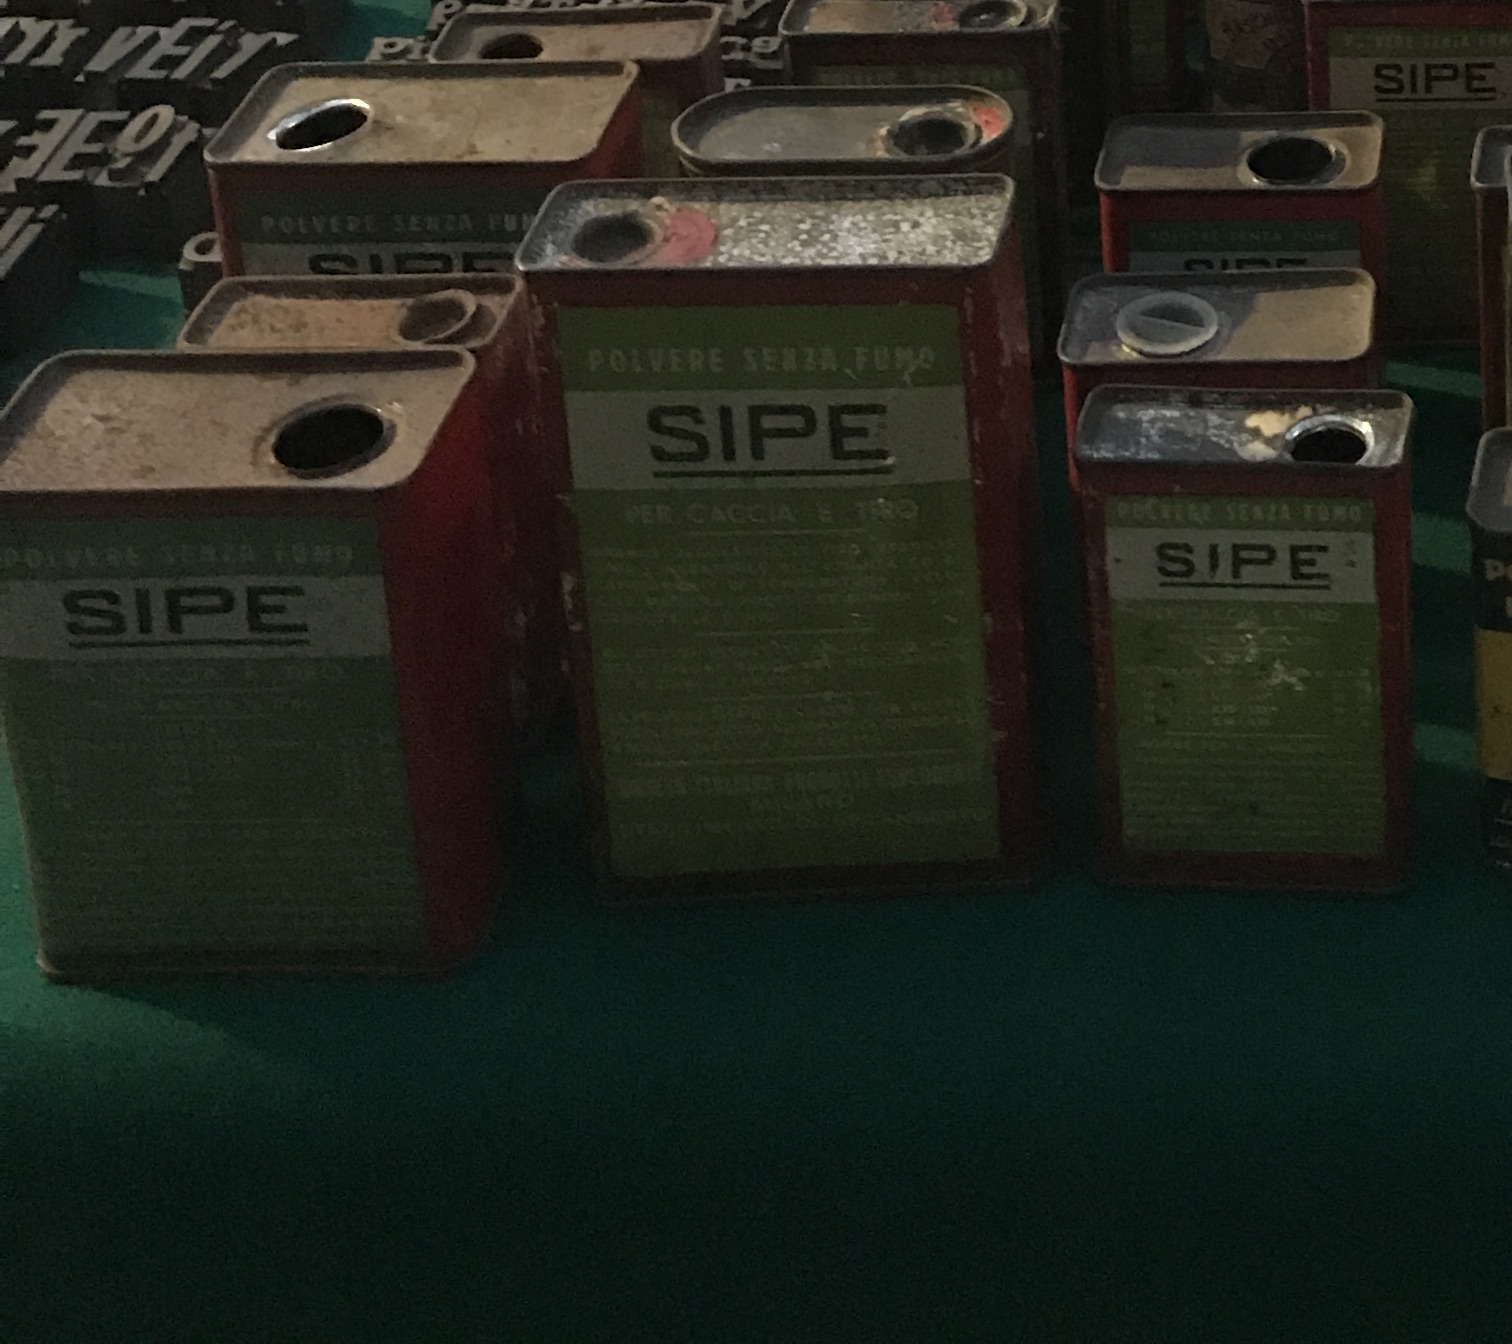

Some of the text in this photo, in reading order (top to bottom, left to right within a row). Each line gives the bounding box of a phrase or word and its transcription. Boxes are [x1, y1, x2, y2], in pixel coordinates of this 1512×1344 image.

[1374, 62, 1496, 95] SIPE
[588, 345, 935, 373] POLVERE SENZA FUMO
[648, 403, 890, 462] SIPE
[1156, 542, 1332, 581] SIPE
[62, 585, 309, 635] SIPE
